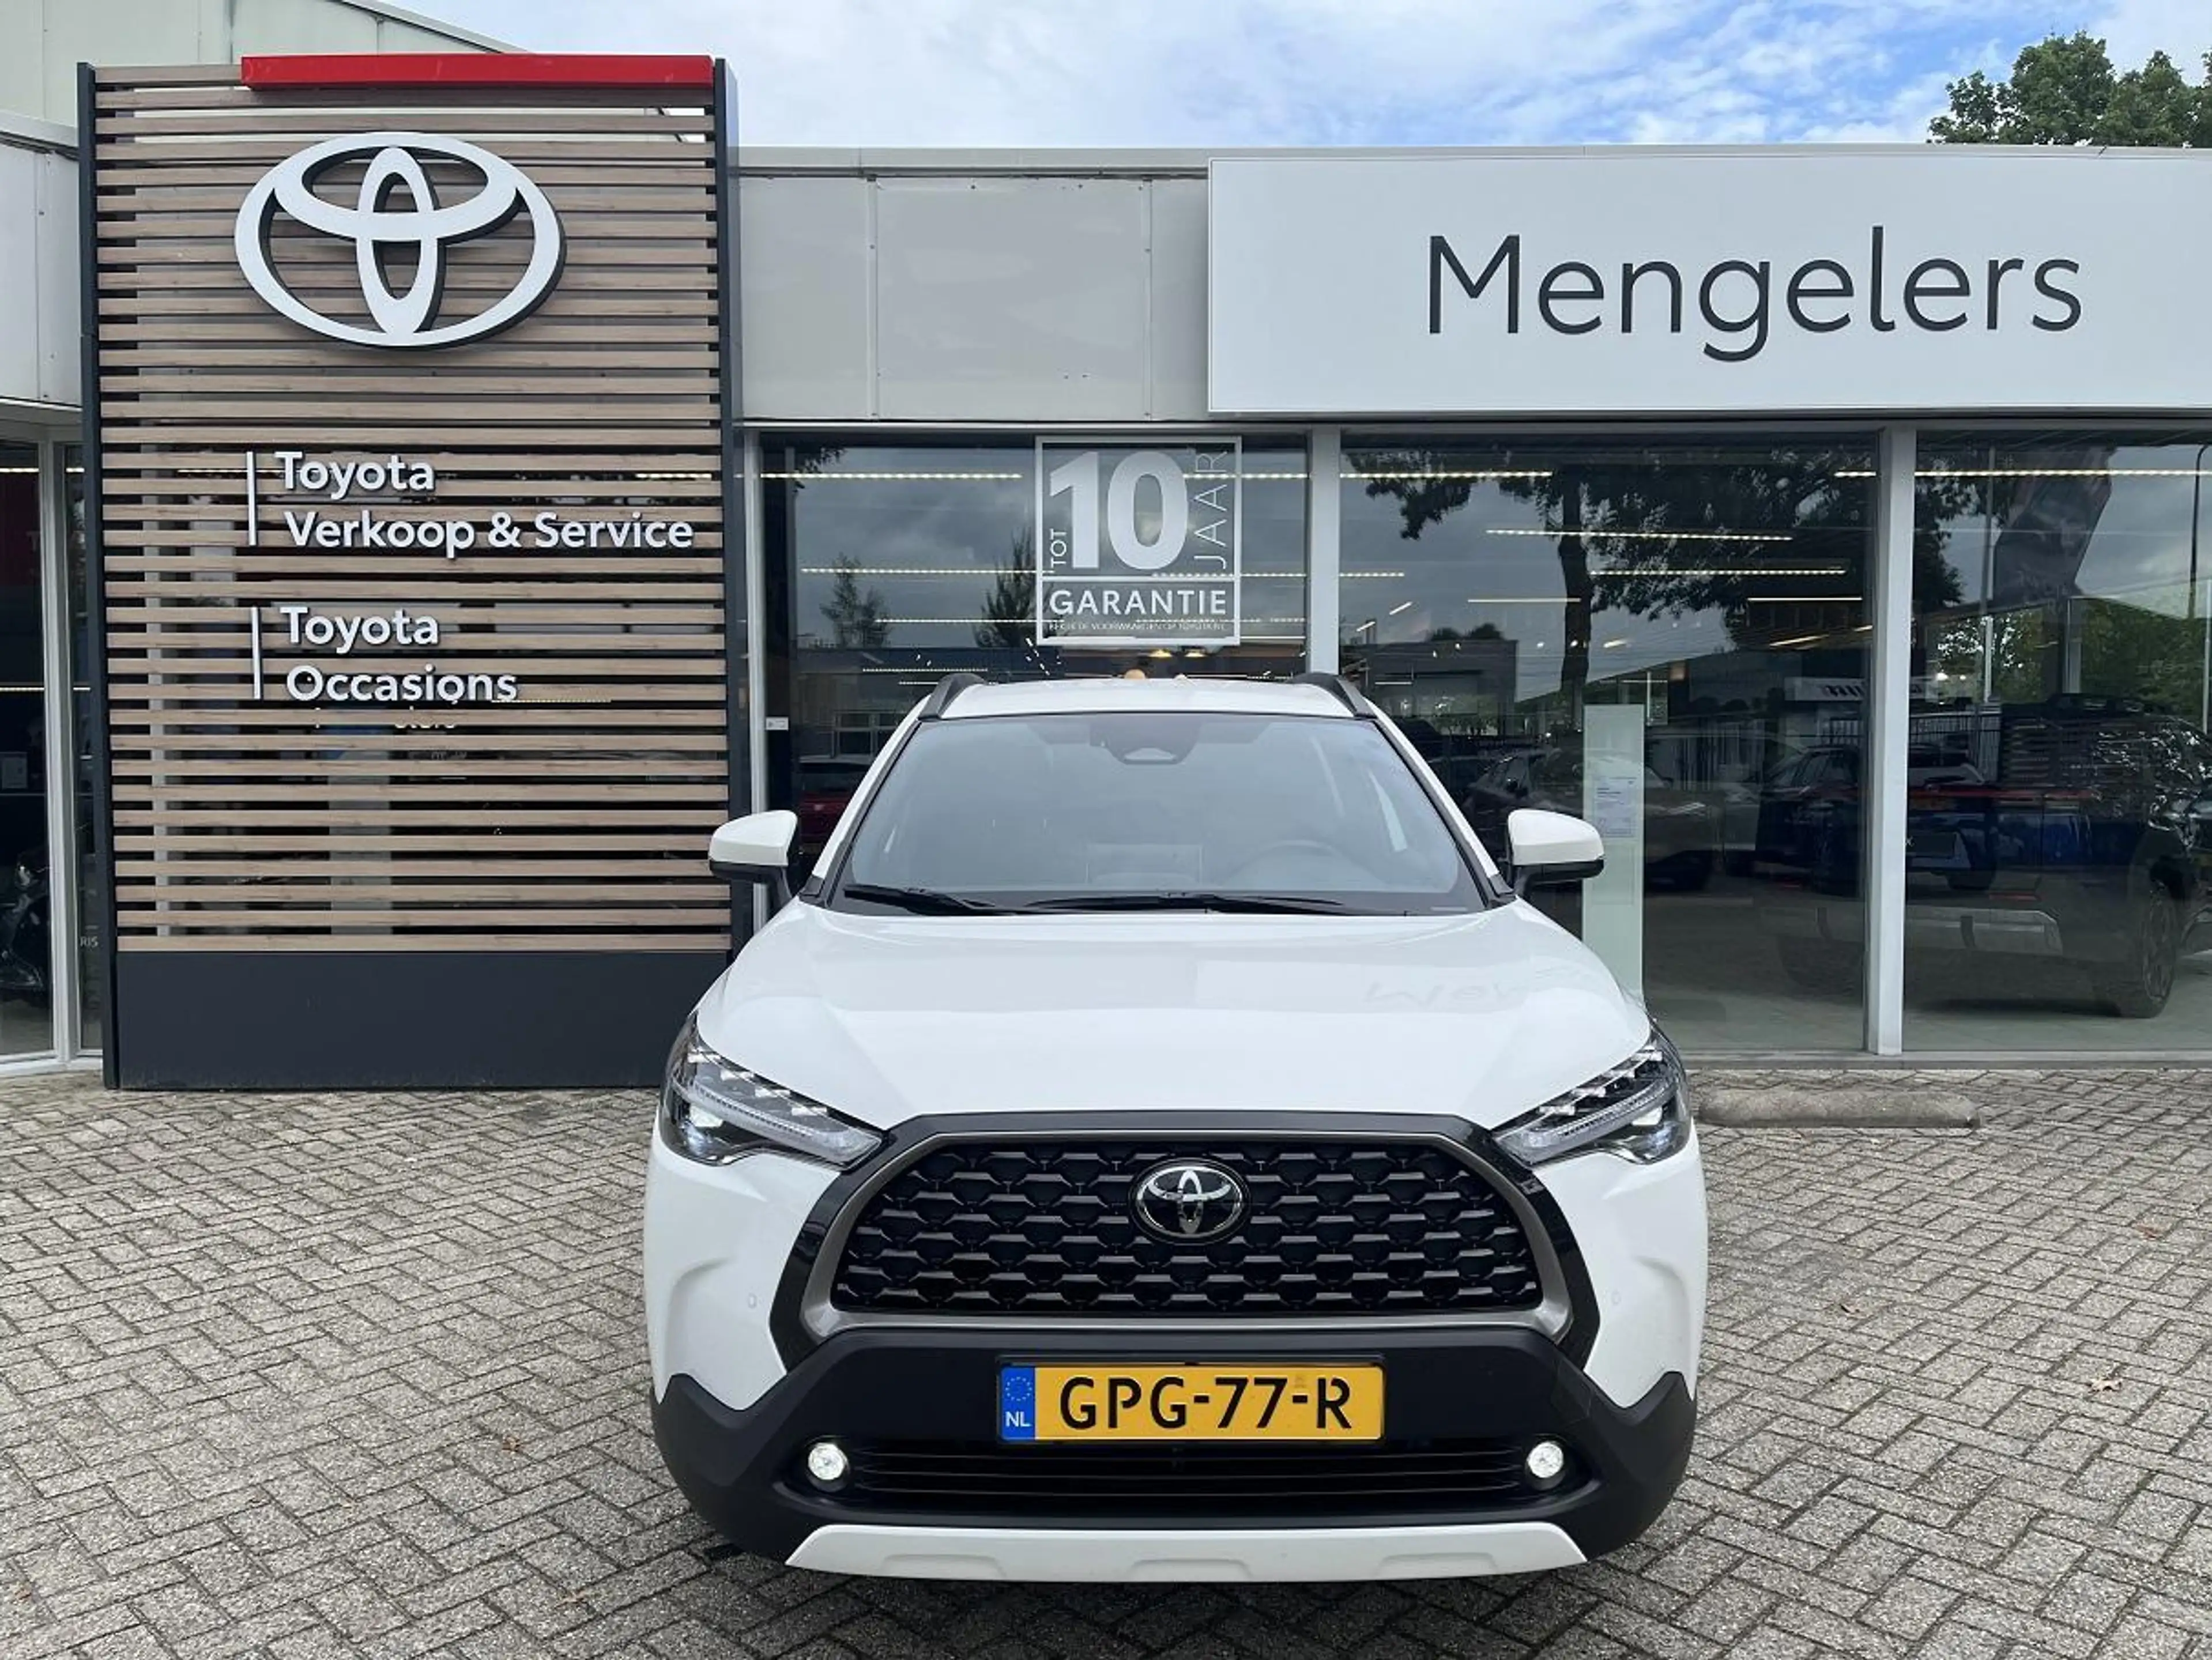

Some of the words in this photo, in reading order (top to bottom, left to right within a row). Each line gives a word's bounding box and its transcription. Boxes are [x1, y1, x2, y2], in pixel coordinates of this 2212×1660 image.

[1429, 225, 2082, 362] Mengelers
[274, 451, 435, 499] Toyota
[1049, 451, 1188, 570] 10
[1193, 451, 1228, 569] JAAR
[284, 511, 476, 559] Verkoop
[488, 511, 522, 549] &
[534, 511, 694, 549] Service
[1049, 528, 1068, 568] TOT
[1049, 590, 1227, 616] GARANTIE
[280, 606, 440, 654] Toyota
[286, 663, 519, 703] Occasions
[1005, 1411, 1031, 1428] NL
[1060, 1376, 1352, 1429] GPG-77-R
